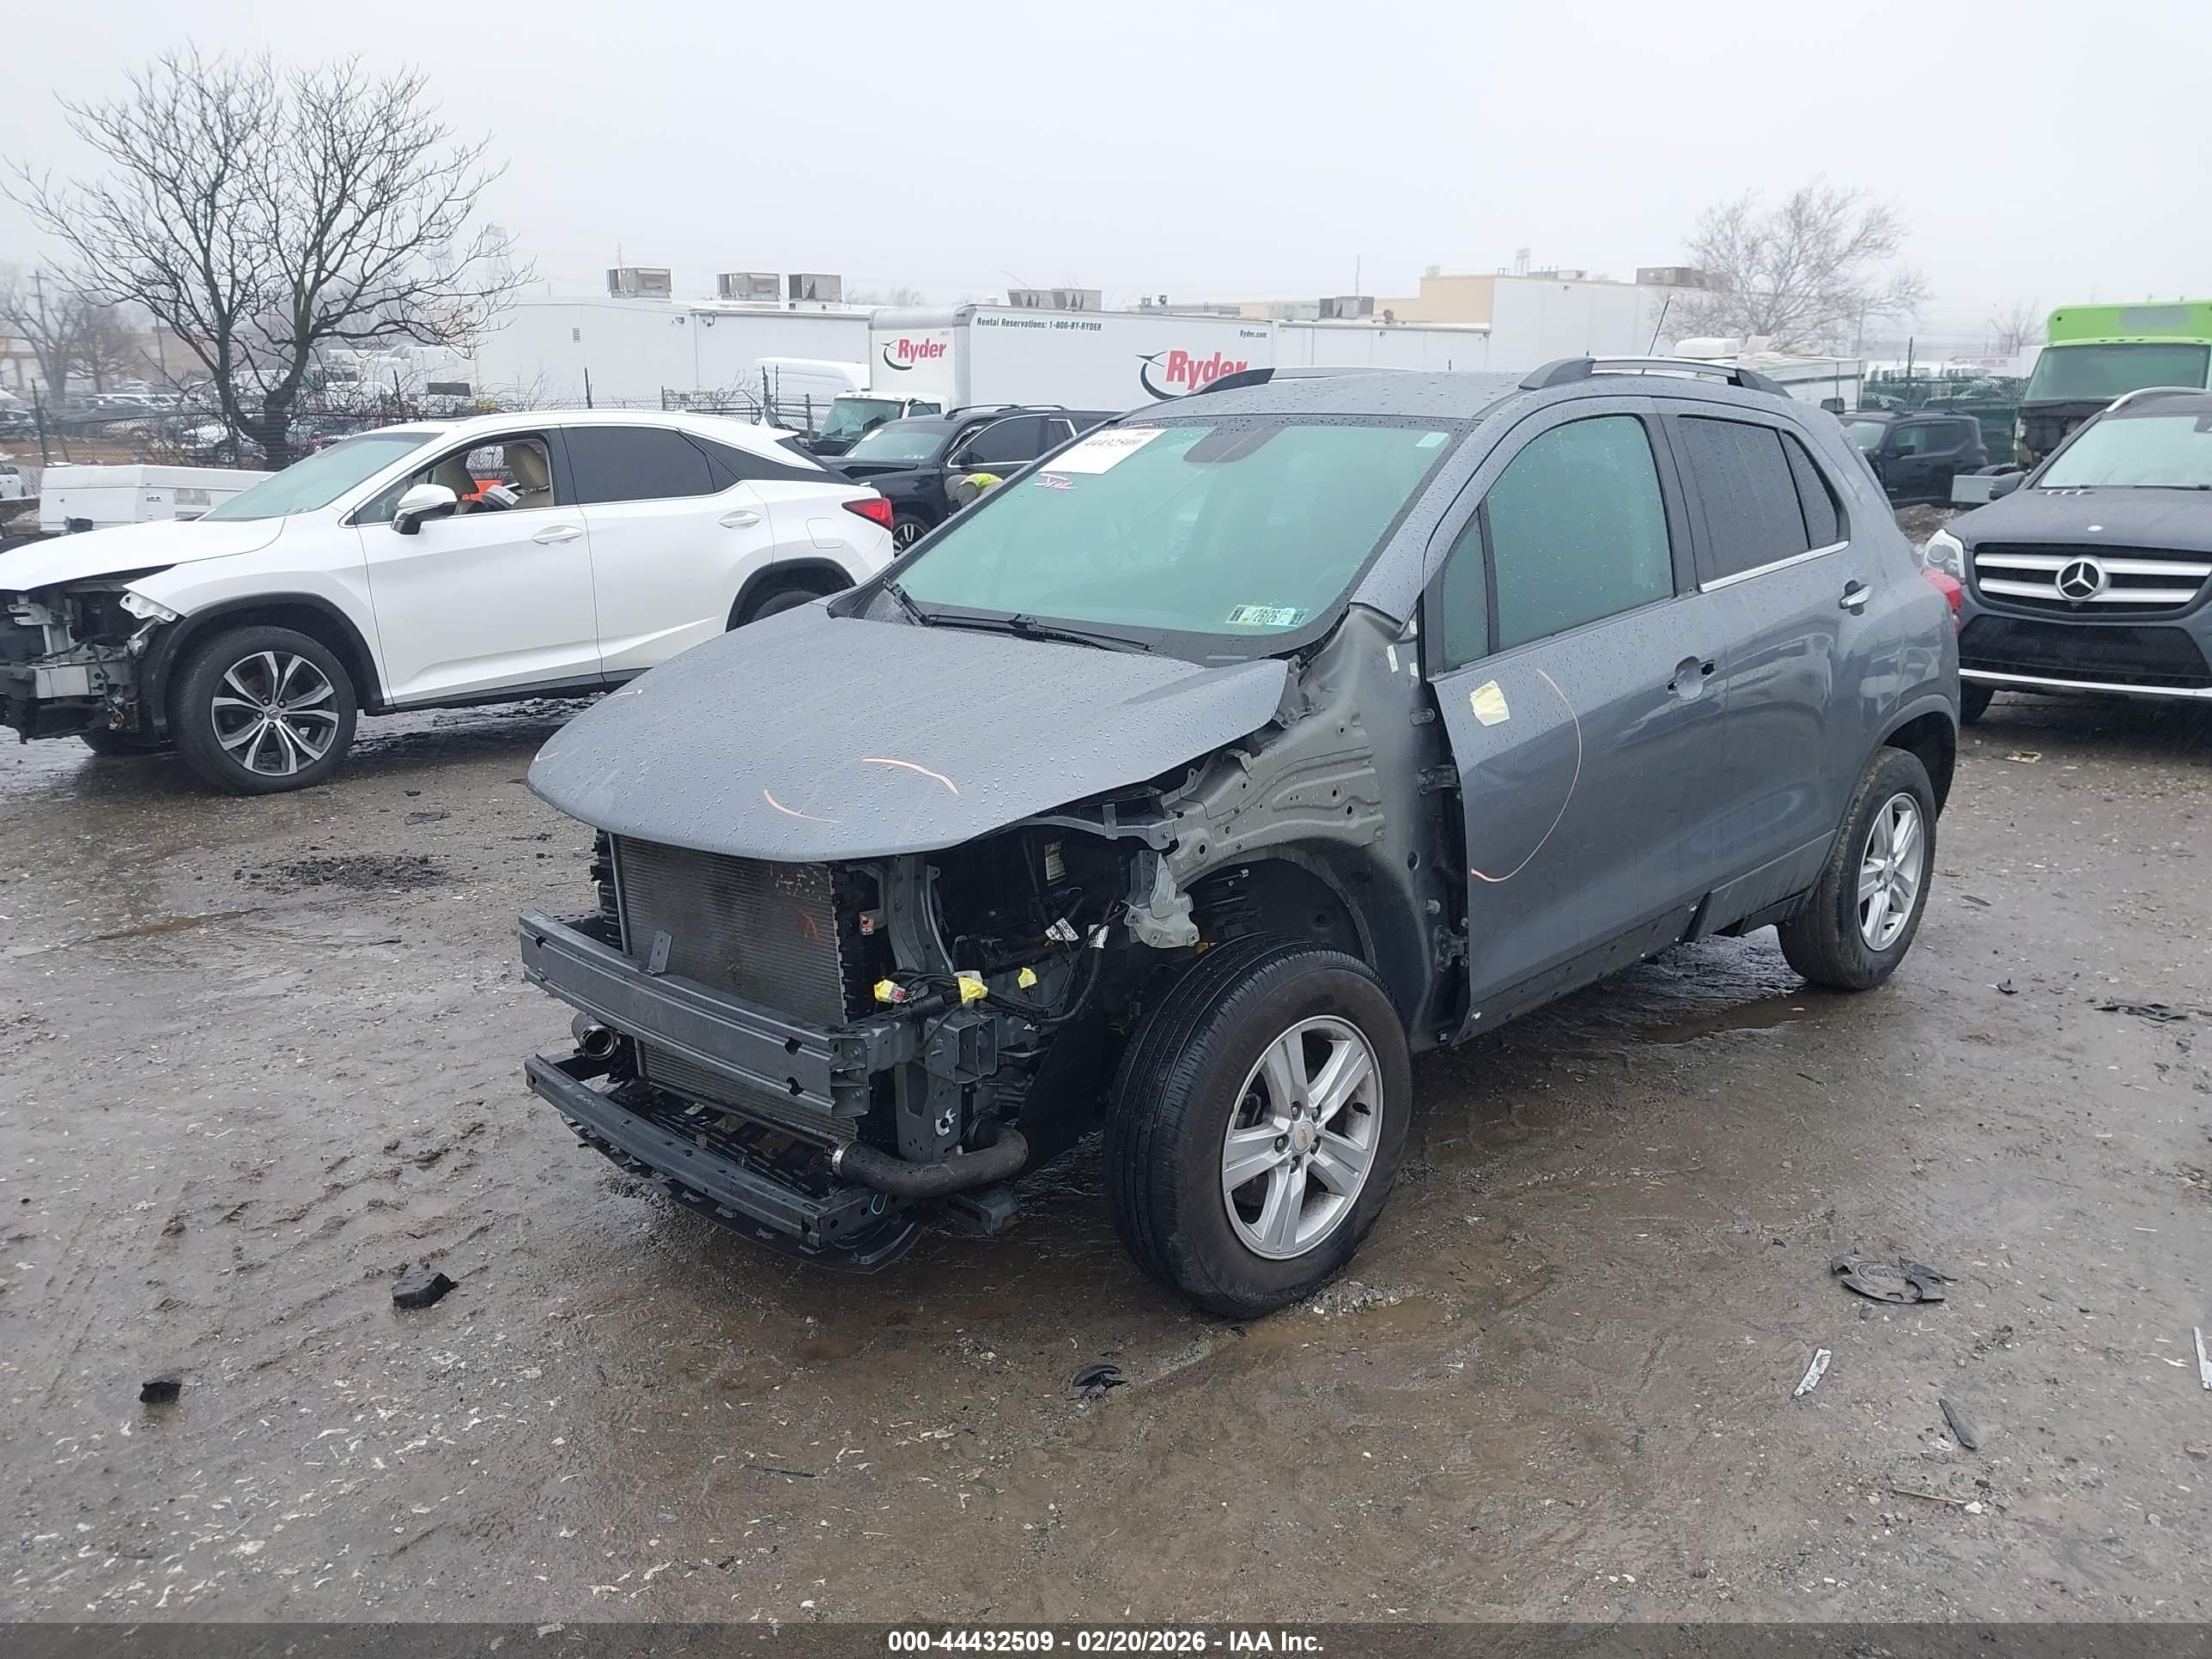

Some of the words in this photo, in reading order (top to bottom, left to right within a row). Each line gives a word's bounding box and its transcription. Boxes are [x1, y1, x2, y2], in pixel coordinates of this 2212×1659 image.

[976, 317, 999, 326] Rental
[1000, 318, 1048, 329] Reservations:
[1048, 323, 1103, 331] 1-800-BY-RYDER
[1239, 329, 1267, 338] Ryder.com
[897, 338, 947, 363] Ryder
